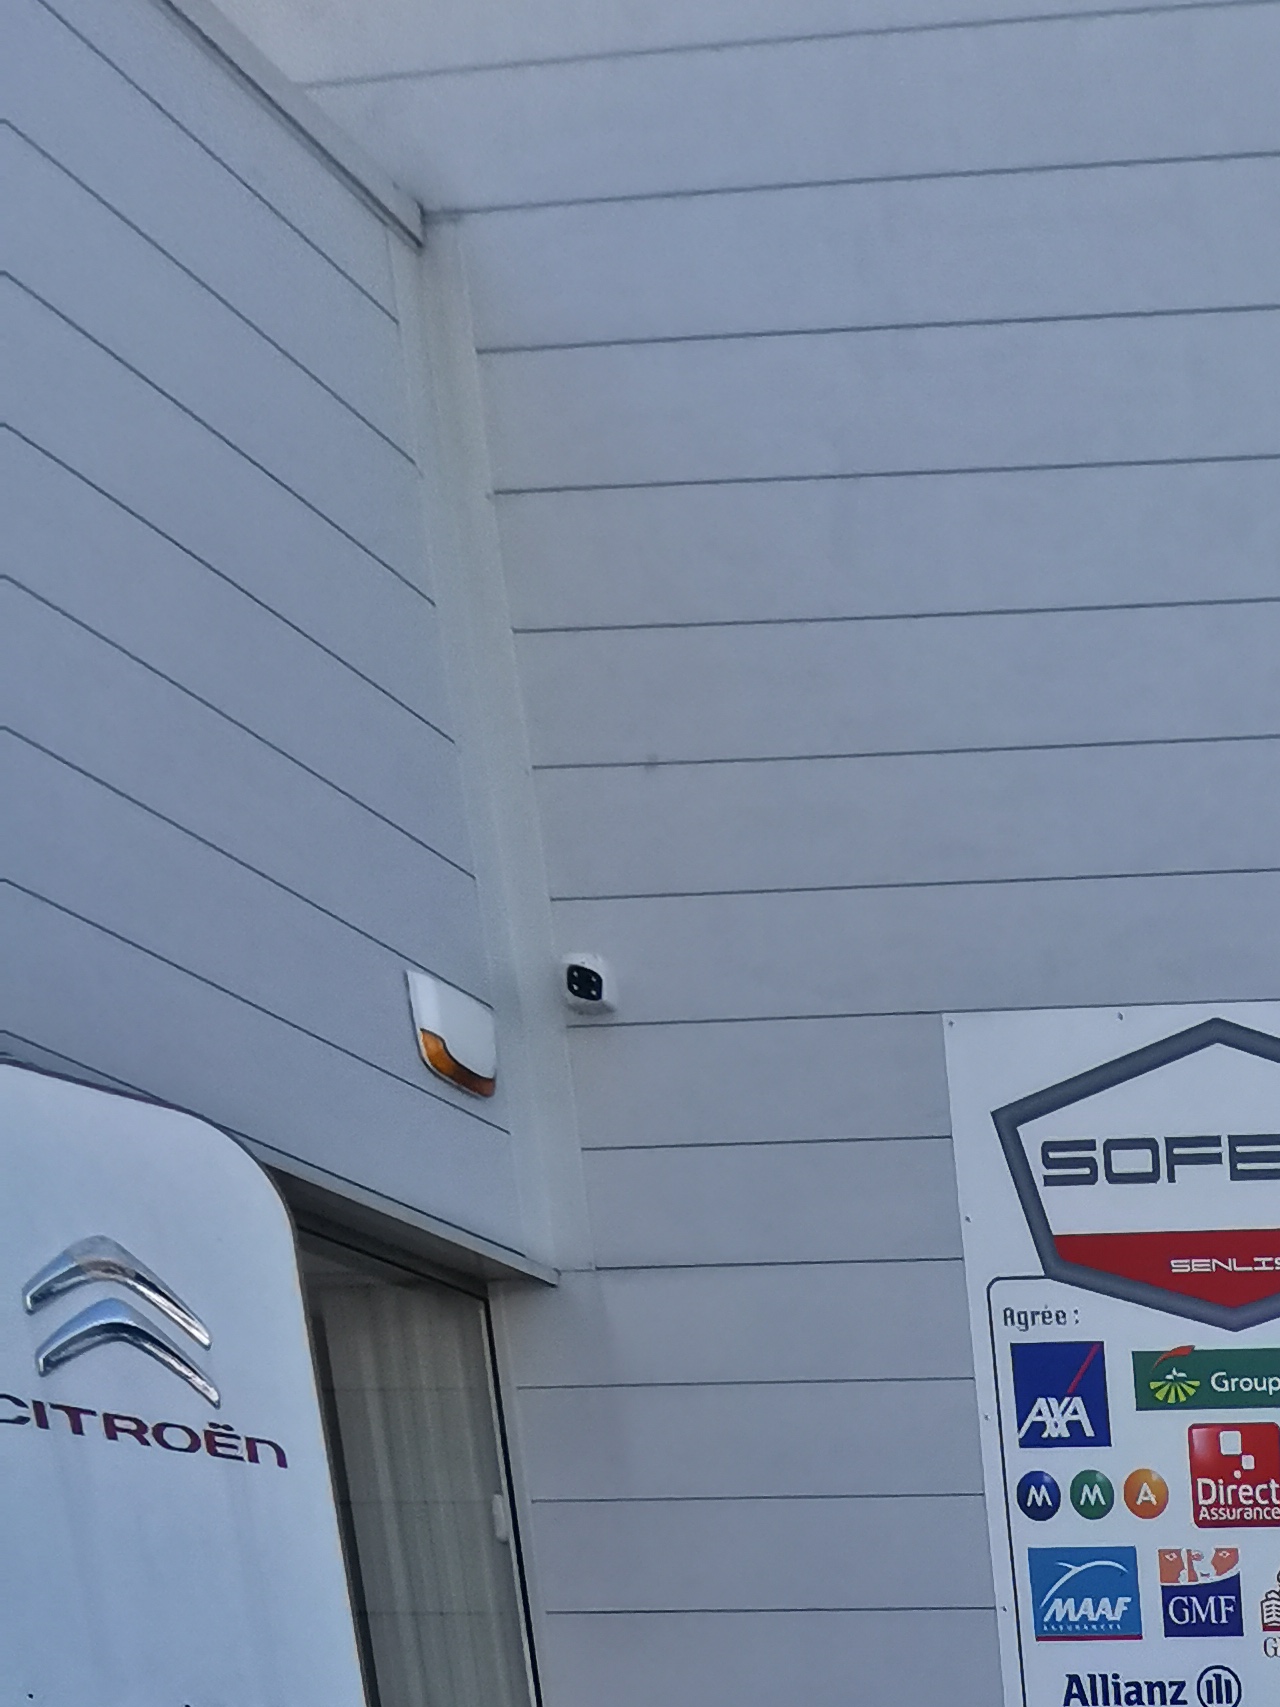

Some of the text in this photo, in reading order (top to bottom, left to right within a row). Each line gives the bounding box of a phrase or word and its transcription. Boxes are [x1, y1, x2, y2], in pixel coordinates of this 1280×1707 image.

[0, 1393, 288, 1469] CITROËN
[1018, 1396, 1096, 1438] AXA
[1043, 1596, 1132, 1622] MAAF
[1168, 1595, 1237, 1625] GMF
[1062, 1672, 1189, 1707] Allianz
